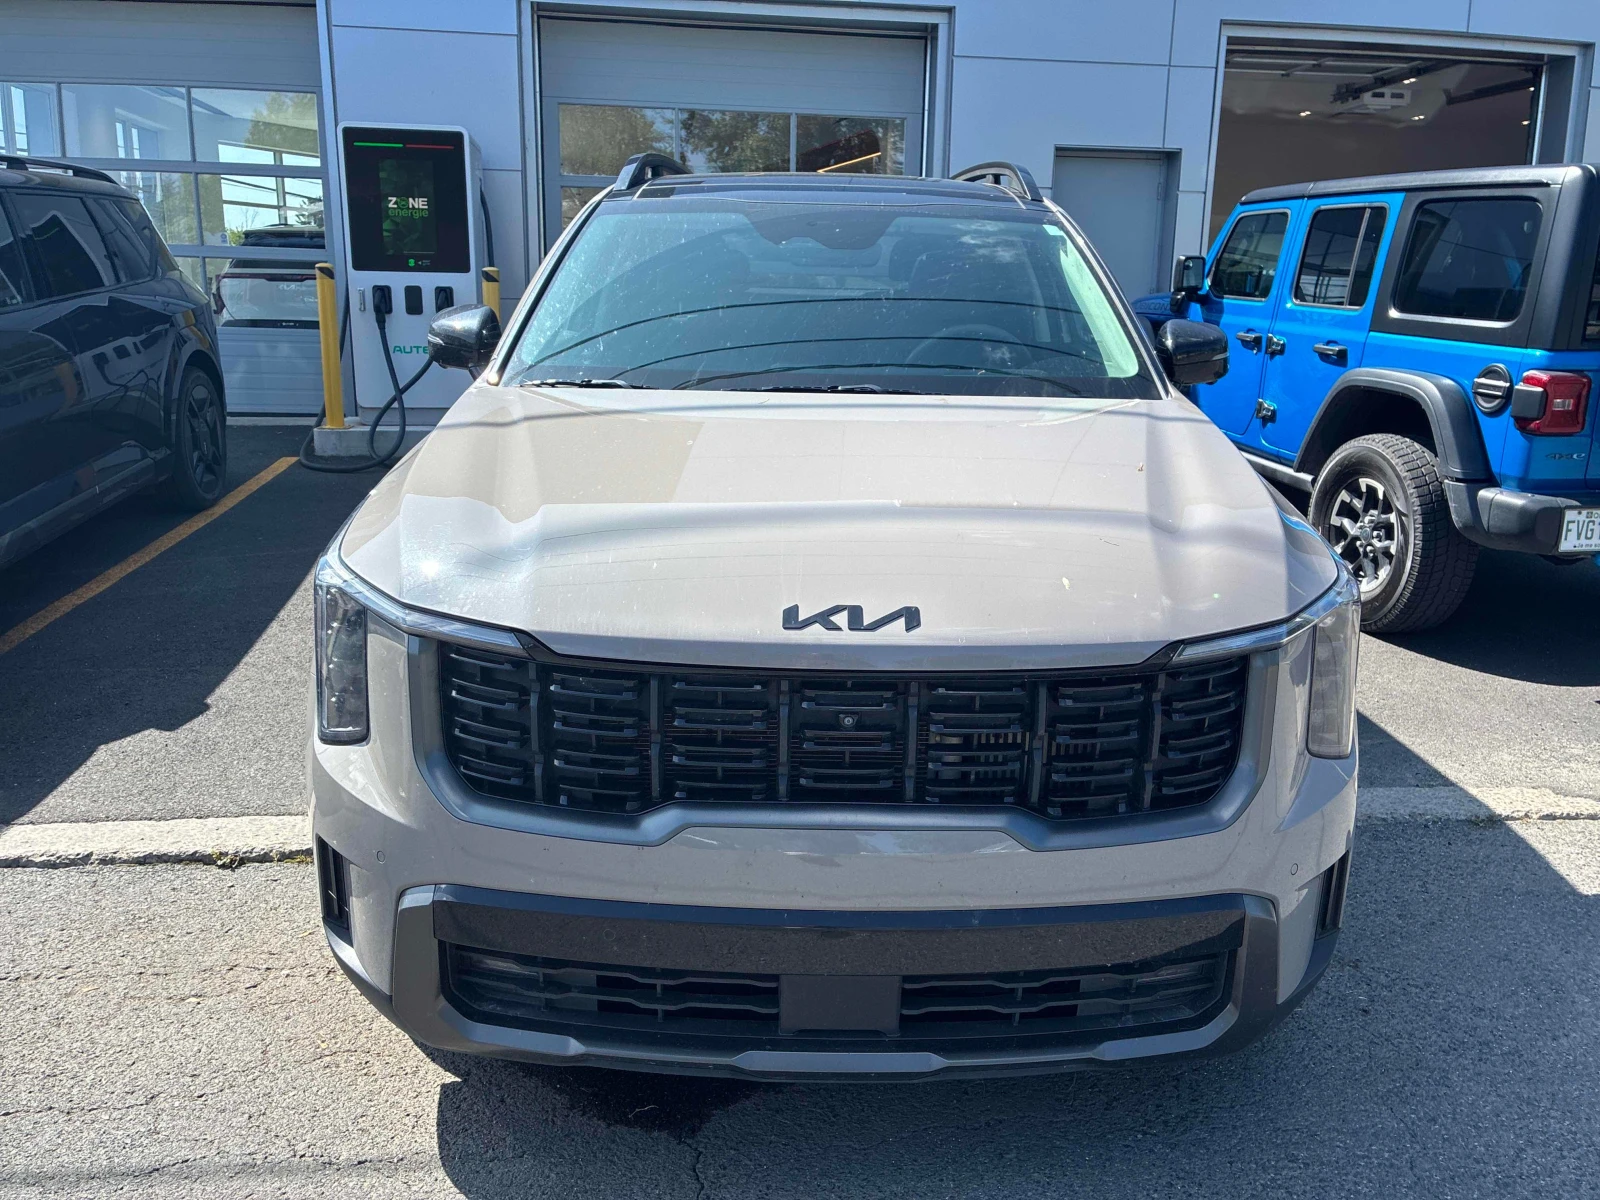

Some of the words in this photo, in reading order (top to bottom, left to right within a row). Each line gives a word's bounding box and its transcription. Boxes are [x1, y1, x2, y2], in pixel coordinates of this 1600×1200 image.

[388, 197, 428, 208] ZONE
[1134, 301, 1170, 311] UBICON
[393, 345, 429, 354] AUTE
[1564, 520, 1600, 541] FVG
[782, 604, 921, 633] KIA
